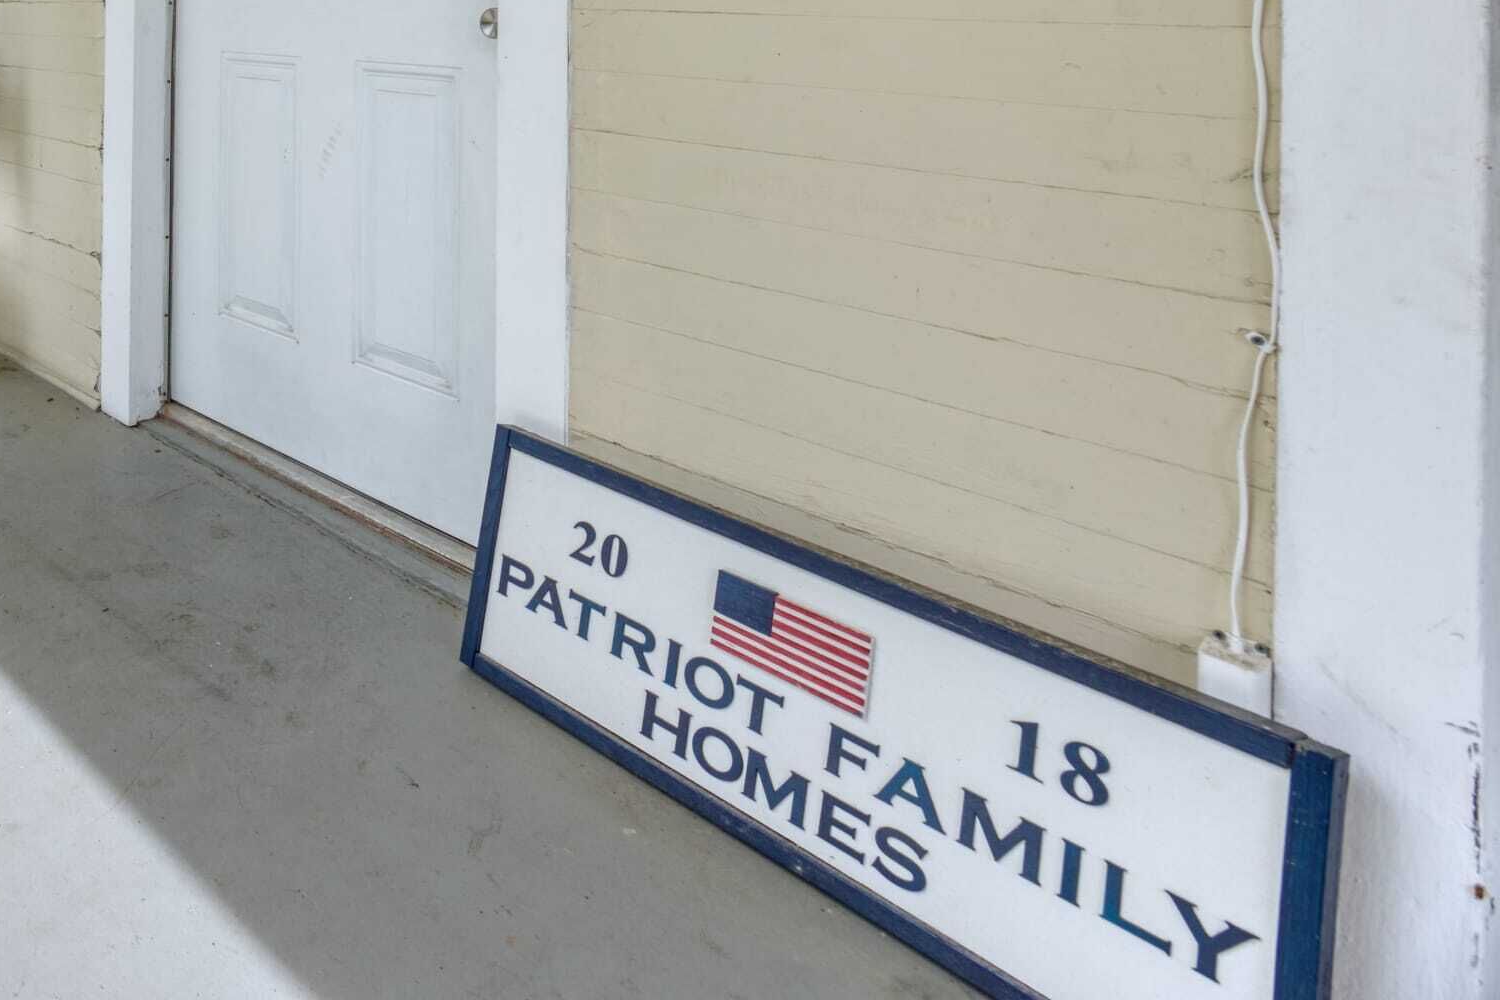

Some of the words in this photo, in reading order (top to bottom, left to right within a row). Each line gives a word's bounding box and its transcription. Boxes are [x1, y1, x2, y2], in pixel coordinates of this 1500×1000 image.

[496, 553, 785, 736] PATRIOT
[823, 722, 1261, 984] FAMILY
[569, 520, 629, 578] 20
[1006, 720, 1111, 807] 18
[639, 689, 929, 893] HOMES
